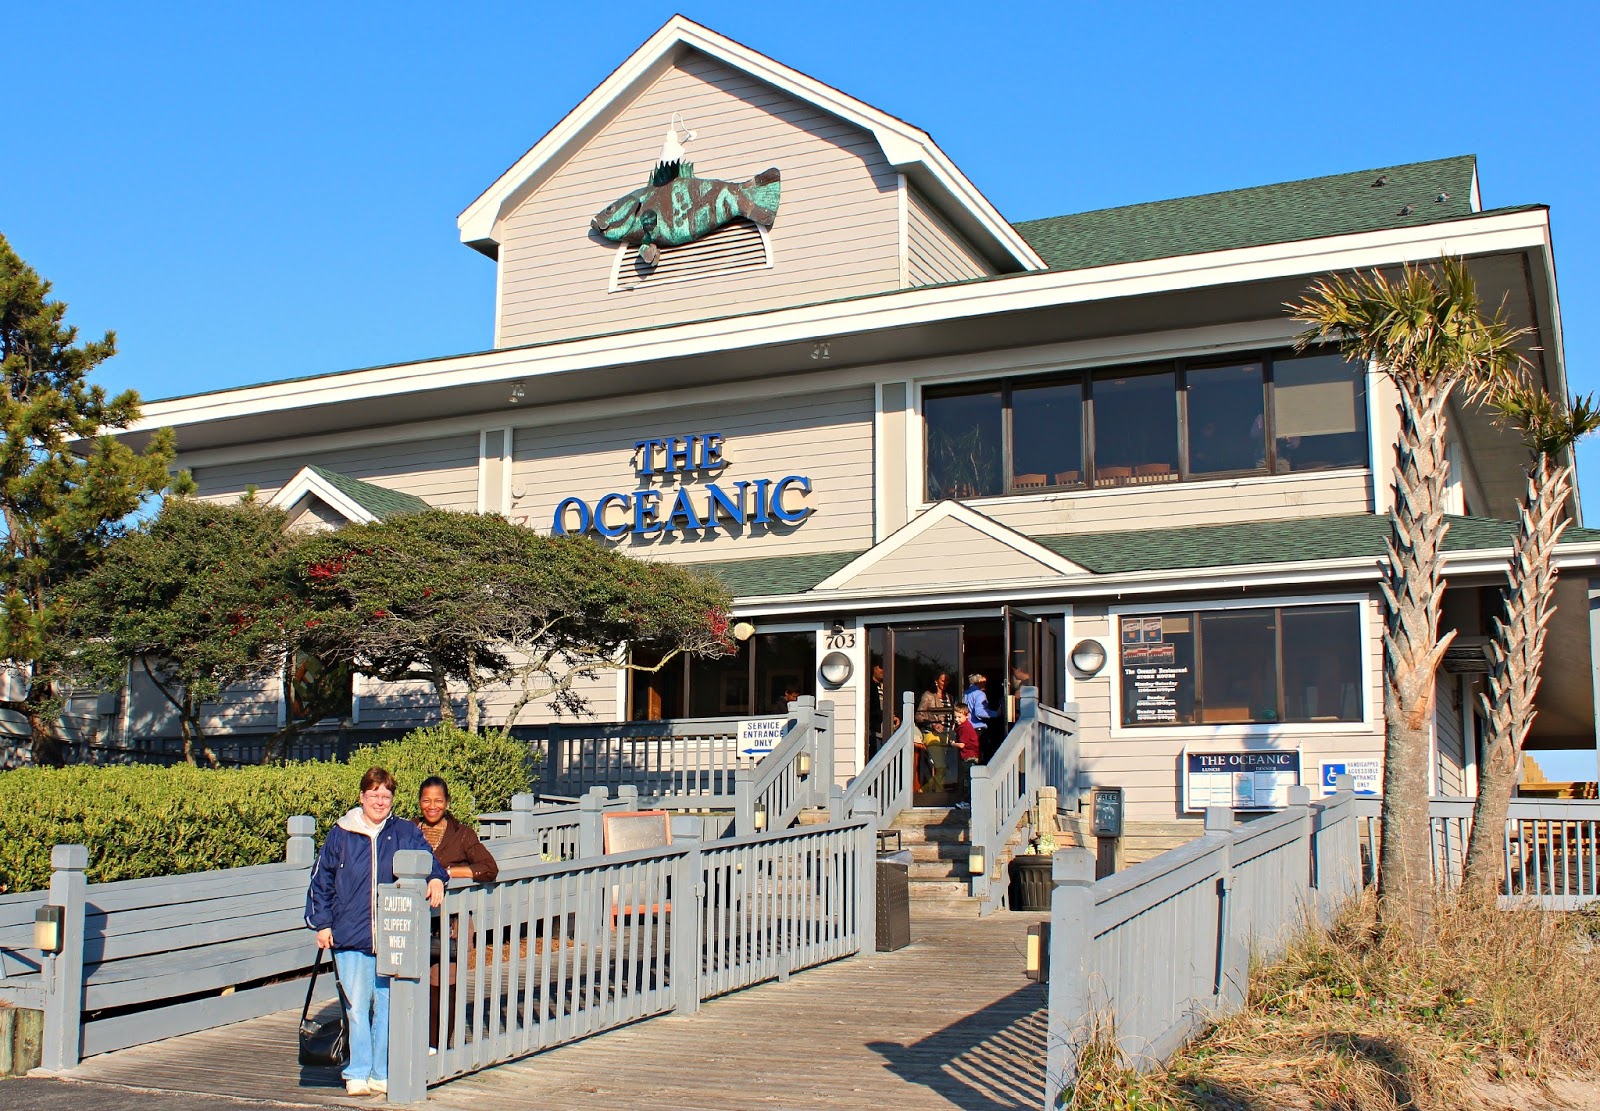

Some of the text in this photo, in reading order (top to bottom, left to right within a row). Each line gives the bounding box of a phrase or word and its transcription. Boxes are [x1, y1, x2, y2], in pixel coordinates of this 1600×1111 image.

[633, 432, 727, 476] THE
[553, 475, 812, 537] OCEANIC
[825, 633, 855, 649] 703
[747, 721, 780, 730] SERVICE
[743, 729, 784, 739] ENTRANCE
[754, 738, 773, 747] ONLY
[1199, 754, 1290, 766] THE OCEANIC
[384, 896, 412, 912] CAUTION
[383, 918, 412, 931] SLIPPERY
[389, 935, 406, 949] WHEN
[390, 951, 403, 965] WET
